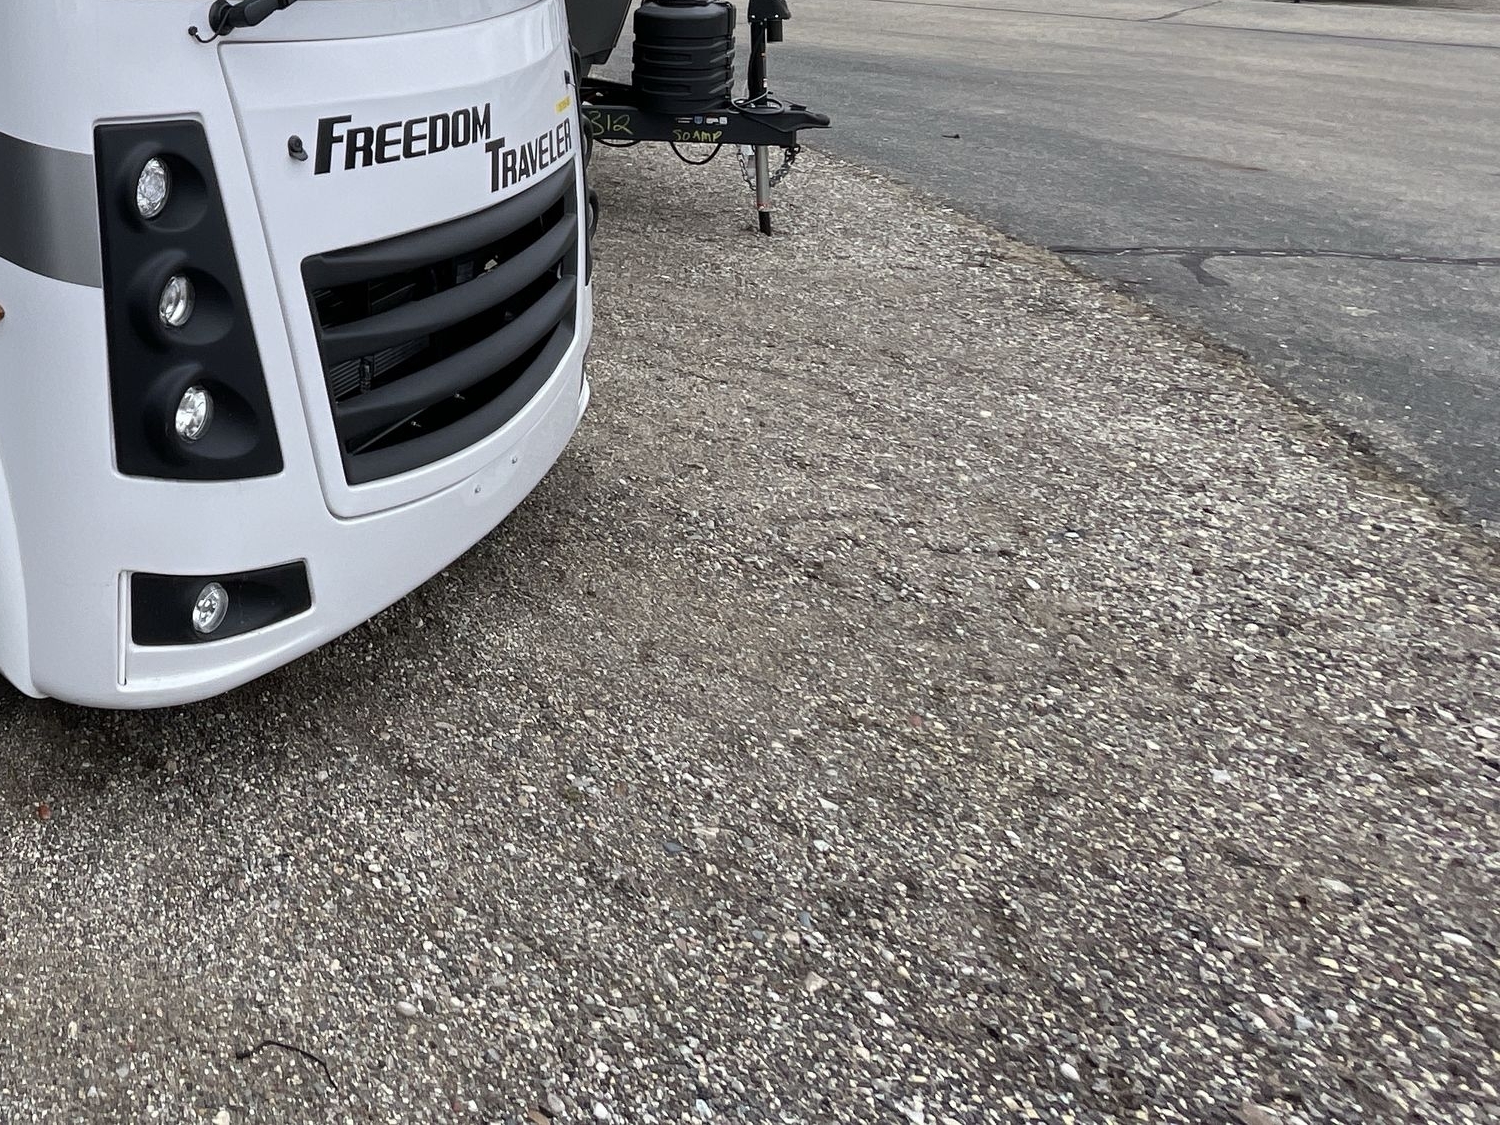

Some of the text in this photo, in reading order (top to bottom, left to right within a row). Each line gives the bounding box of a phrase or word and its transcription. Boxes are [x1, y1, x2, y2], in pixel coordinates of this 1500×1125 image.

[314, 102, 491, 175] FREEDOM
[485, 117, 572, 193] TRAVELER
[692, 129, 723, 142] AMP
